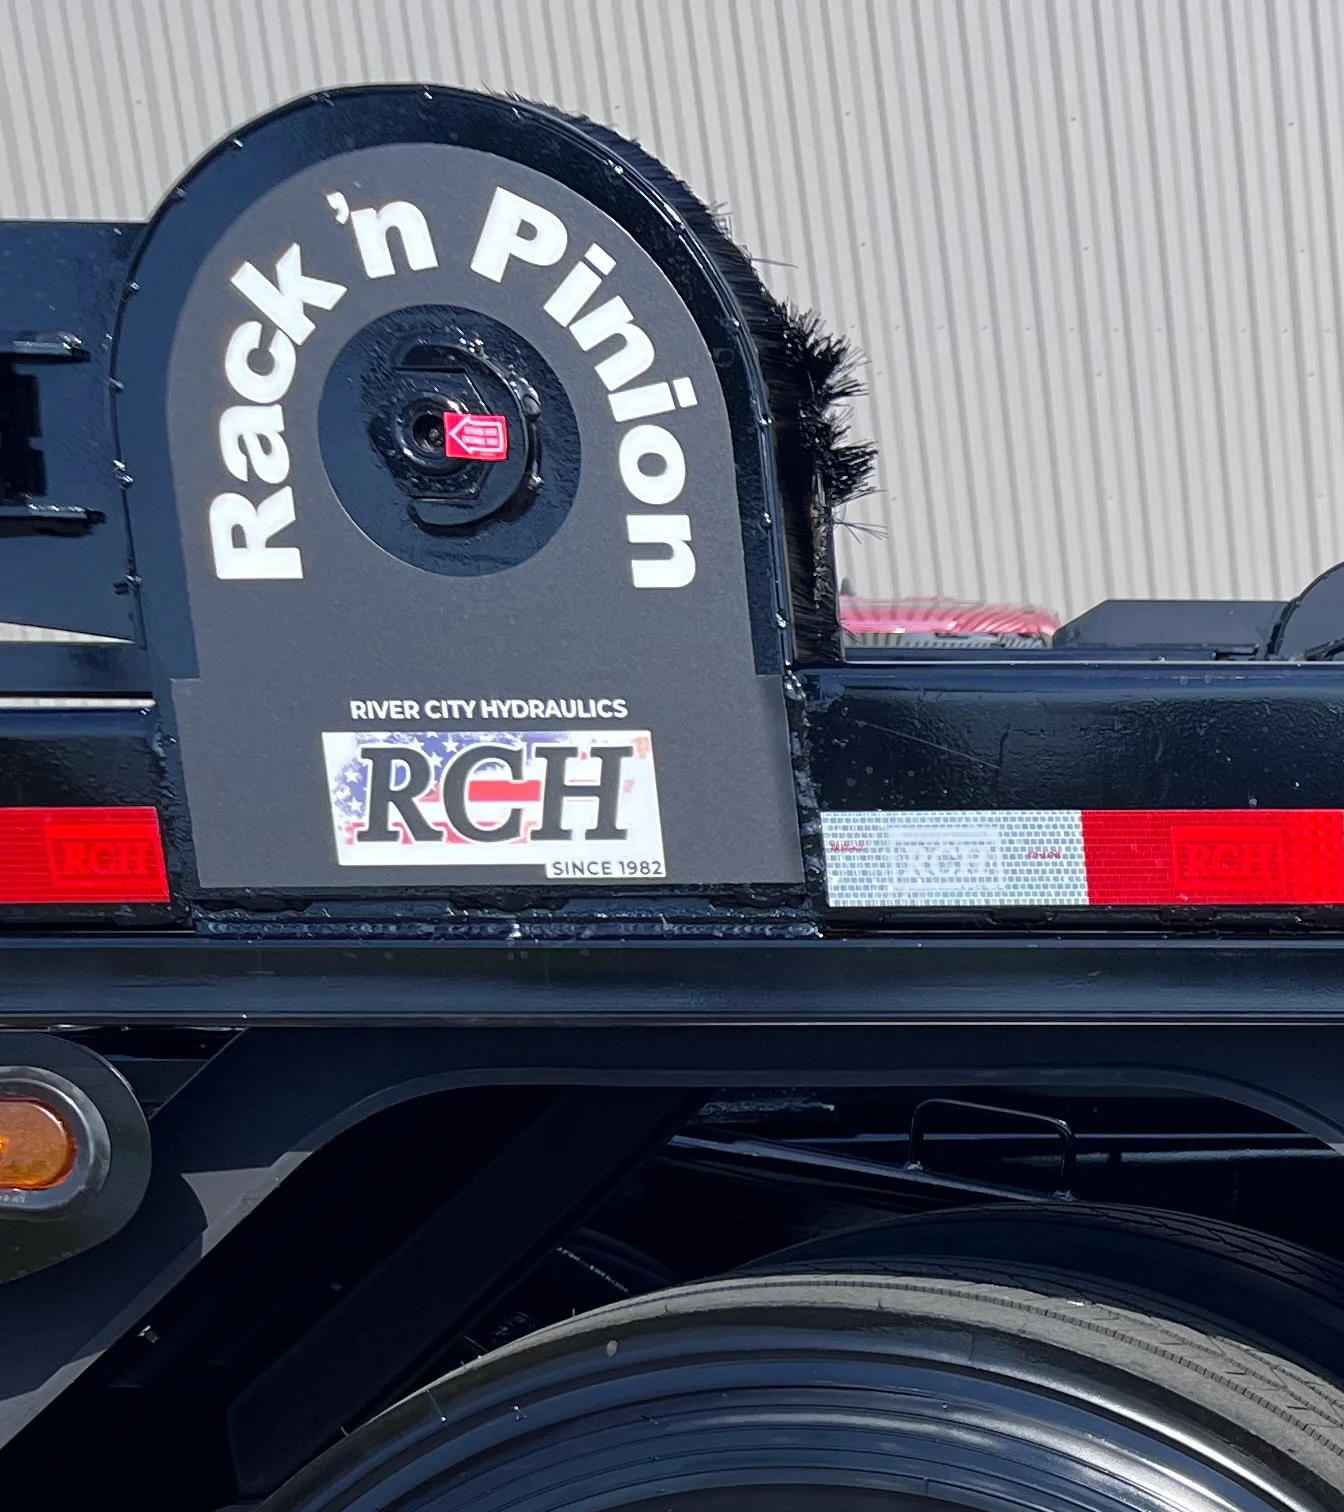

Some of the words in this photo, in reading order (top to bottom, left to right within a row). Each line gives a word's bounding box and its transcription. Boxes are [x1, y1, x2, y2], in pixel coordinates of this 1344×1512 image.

[208, 241, 348, 580] Rack
[470, 186, 698, 588] Pinion
[351, 700, 420, 719] RIVER
[425, 700, 476, 719] CITY
[482, 699, 629, 719] HYDRAULICS
[357, 745, 634, 843] RCH
[62, 842, 153, 875] RCH
[553, 861, 613, 876] SINCE
[618, 860, 663, 875] 1982
[1186, 843, 1275, 877] RCH
